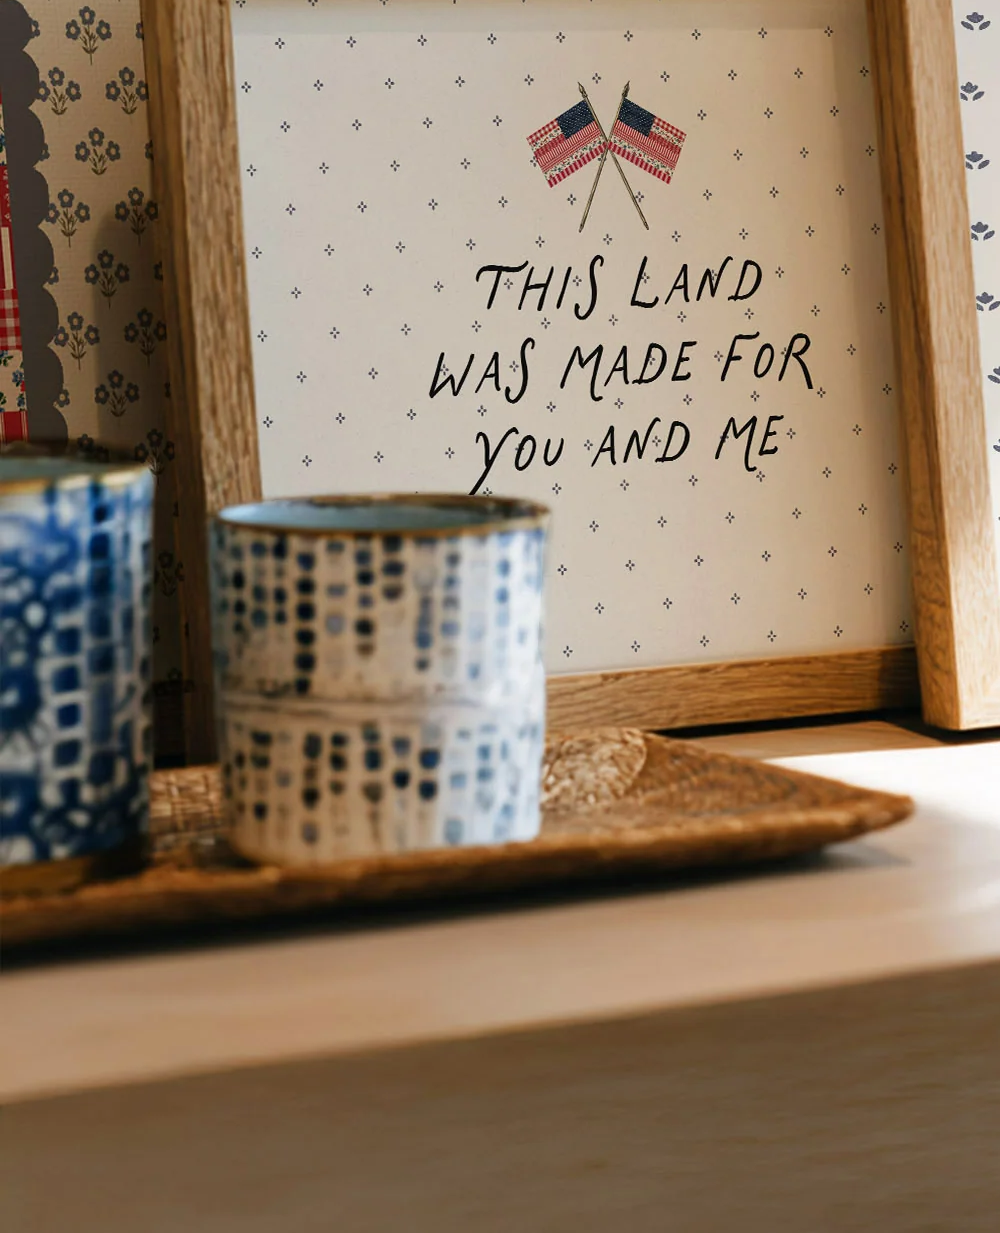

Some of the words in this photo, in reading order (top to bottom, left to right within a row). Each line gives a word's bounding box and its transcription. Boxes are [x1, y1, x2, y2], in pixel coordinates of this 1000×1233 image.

[476, 255, 604, 320] THIS
[631, 256, 763, 309] LAND
[430, 338, 535, 404] WAS
[560, 341, 697, 401] MADE
[721, 331, 814, 389] FOR
[469, 426, 564, 495] YOU
[592, 417, 690, 467] AND
[715, 415, 784, 471] ME
